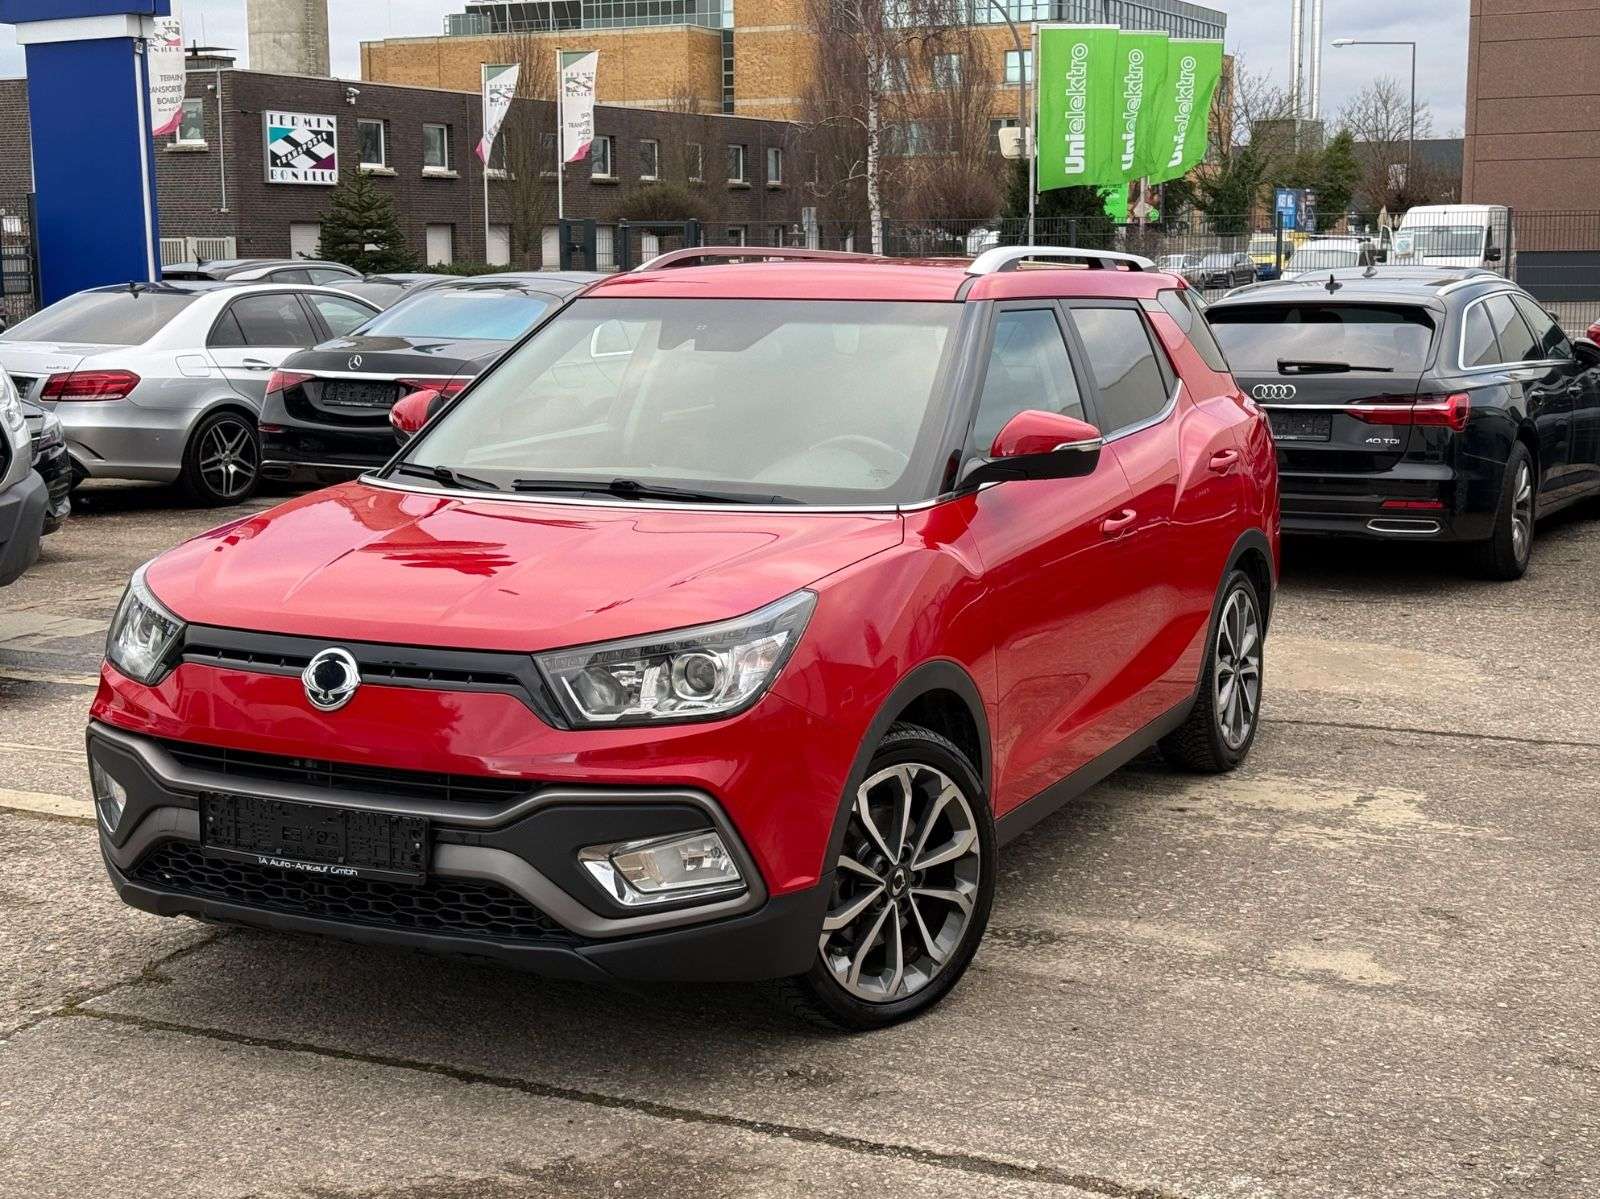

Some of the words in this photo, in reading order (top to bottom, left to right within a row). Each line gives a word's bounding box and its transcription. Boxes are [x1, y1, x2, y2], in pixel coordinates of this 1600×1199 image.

[269, 114, 335, 128] TERMIN
[1065, 43, 1089, 174] Unielektro
[1121, 49, 1144, 171] Unielektro
[1167, 56, 1197, 168] Unielektro
[276, 132, 328, 167] TRANSPORTE
[270, 169, 337, 181] BONILLO
[258, 856, 267, 865] 1A
[270, 859, 327, 873] Auto-Ankauf
